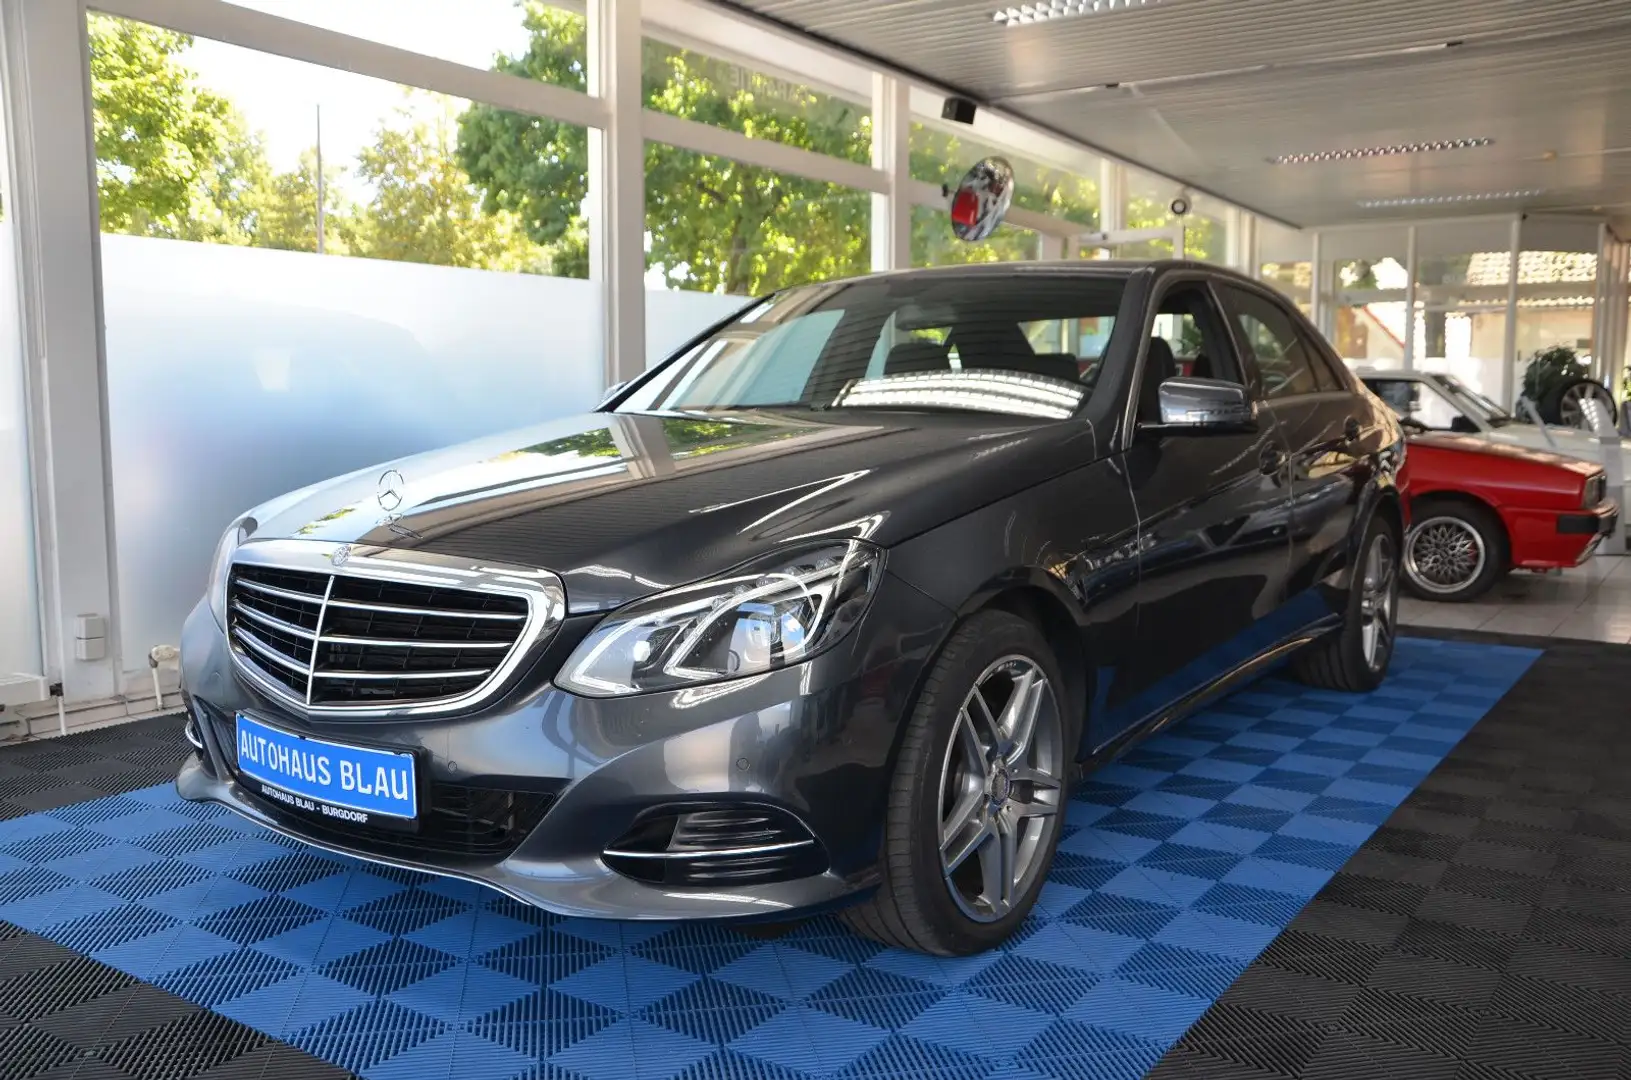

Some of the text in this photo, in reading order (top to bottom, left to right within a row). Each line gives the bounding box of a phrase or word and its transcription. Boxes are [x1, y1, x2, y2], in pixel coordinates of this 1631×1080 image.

[241, 730, 408, 800] AUTOHAUS BLAU
[261, 784, 294, 805] AUTOHAUS
[295, 797, 315, 811] BLAU
[322, 804, 368, 823] BURGDORF
